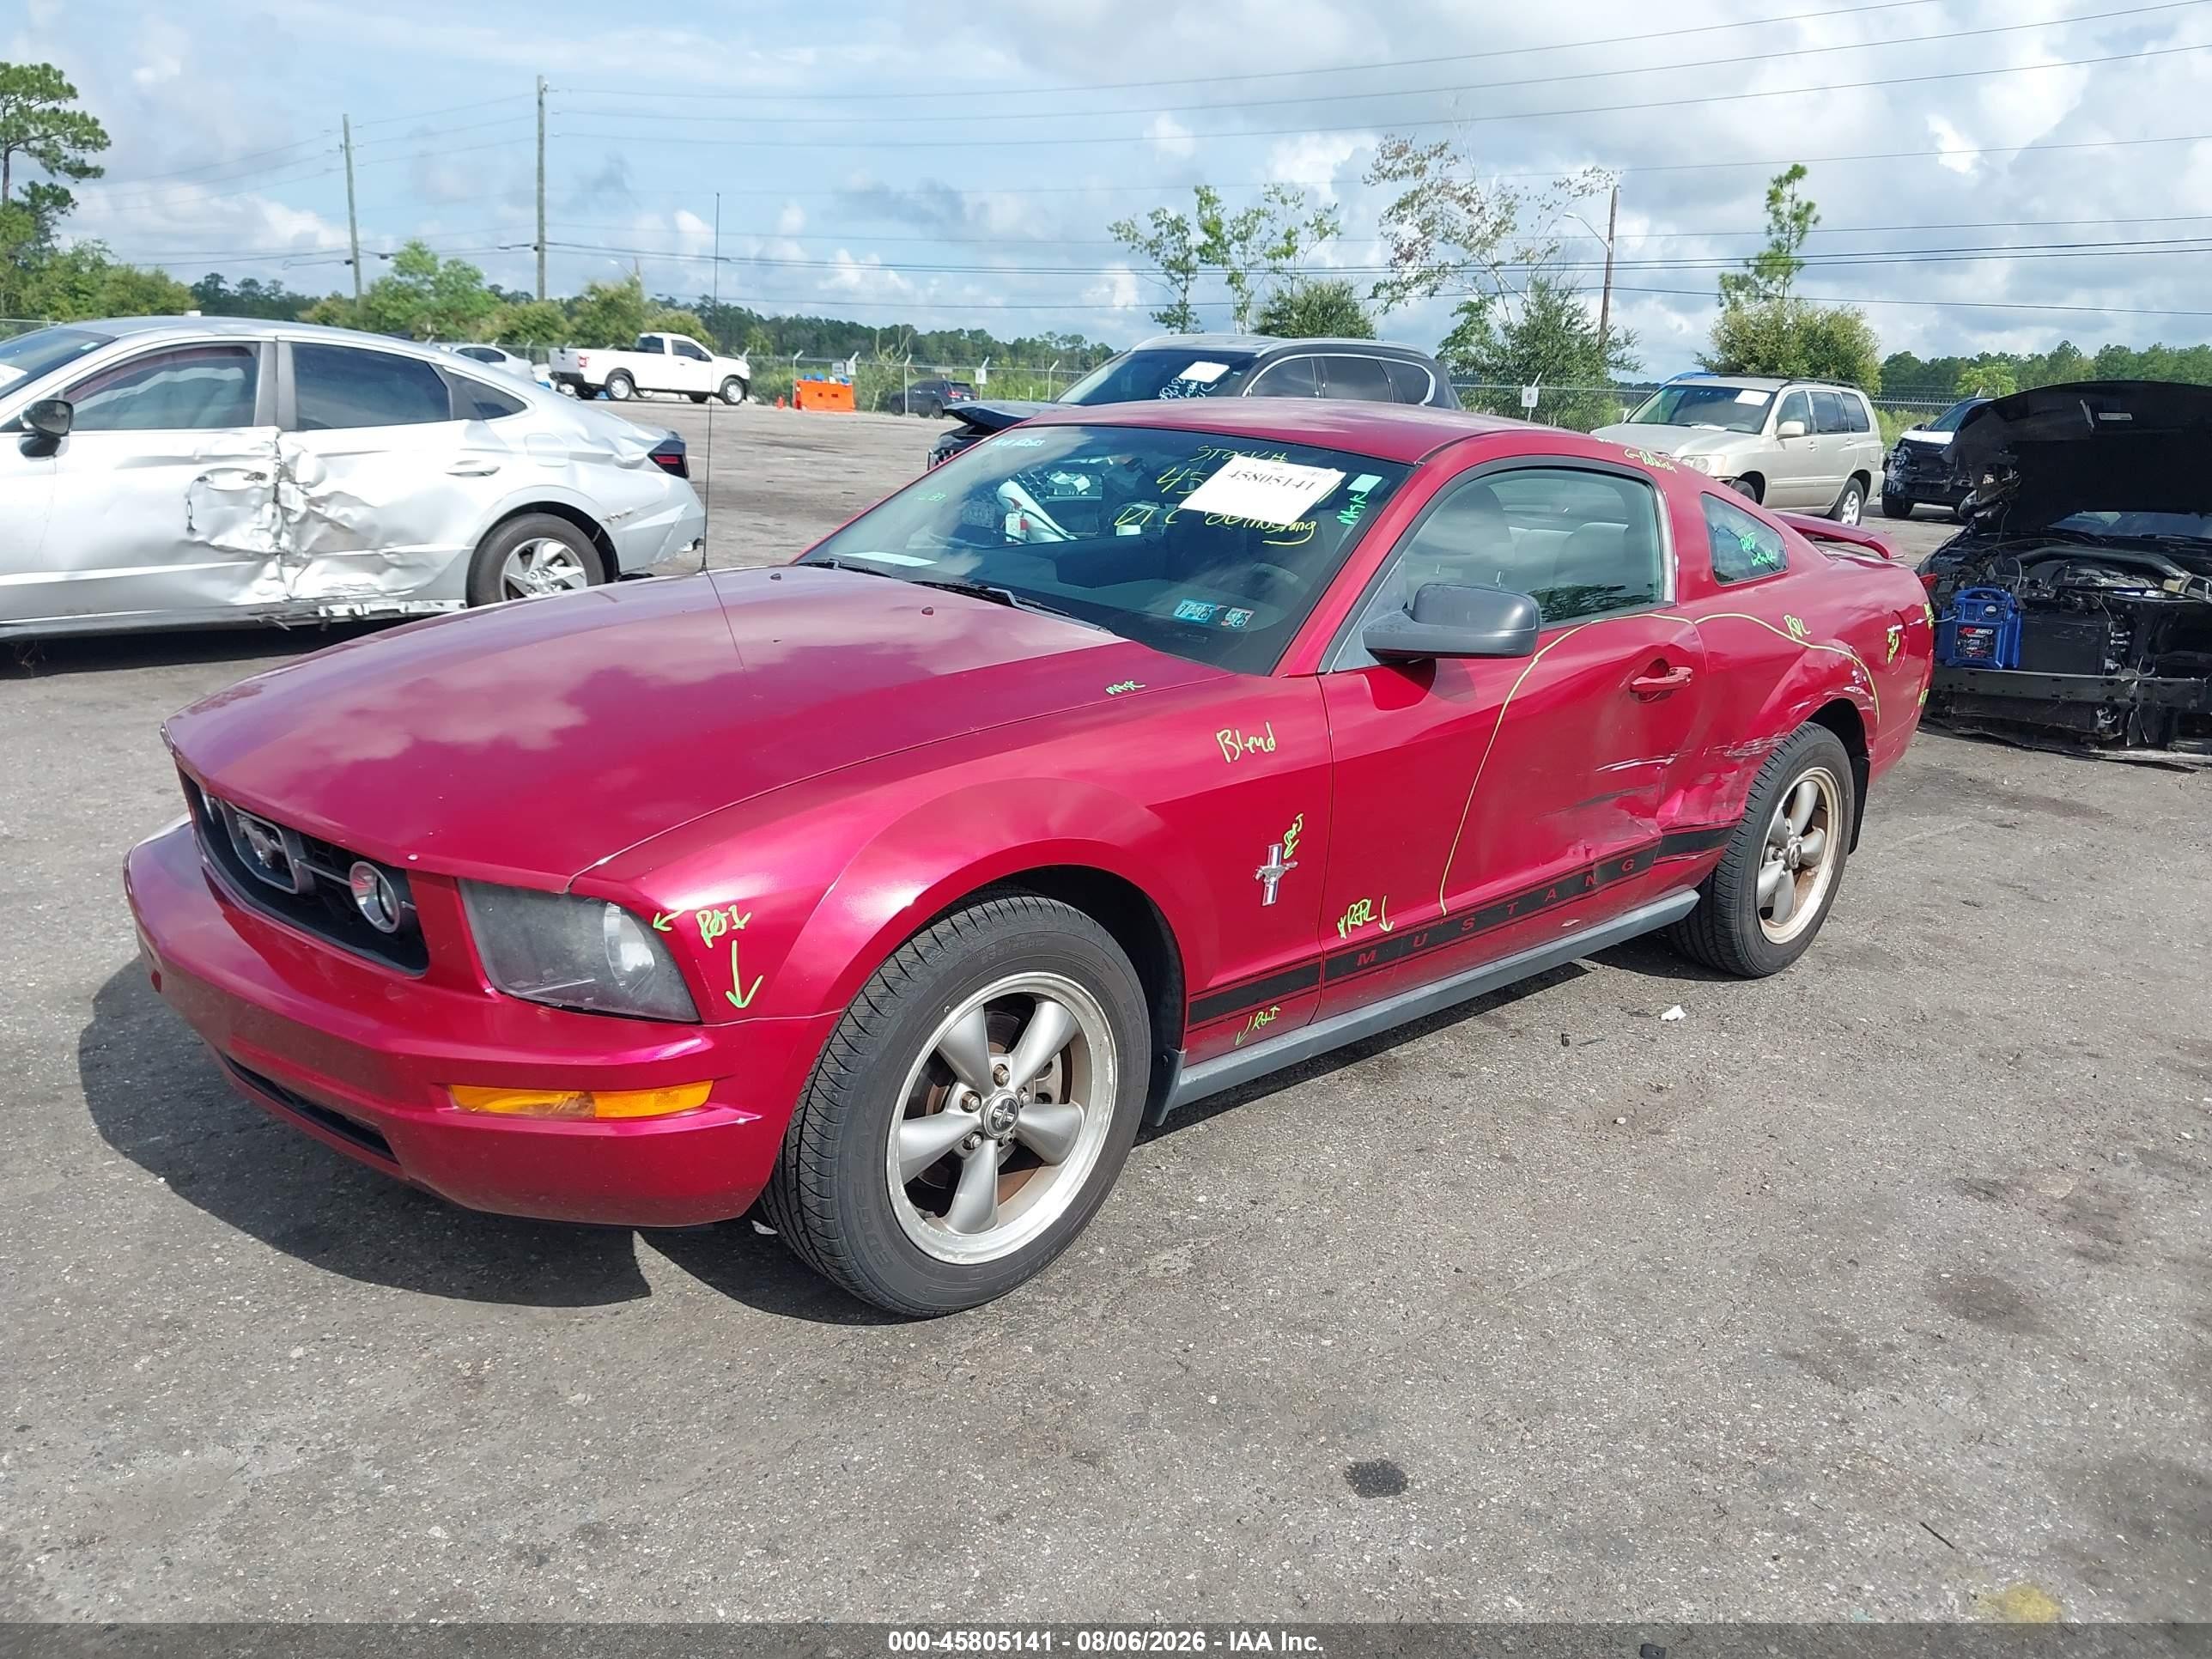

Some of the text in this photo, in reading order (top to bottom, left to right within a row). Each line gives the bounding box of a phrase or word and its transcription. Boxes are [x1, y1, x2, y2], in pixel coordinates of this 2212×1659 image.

[1188, 446, 1269, 461] STOCK
[1228, 470, 1316, 490] 45805141
[1216, 721, 1276, 763] Blend
[1357, 859, 1636, 967] MUSTANG
